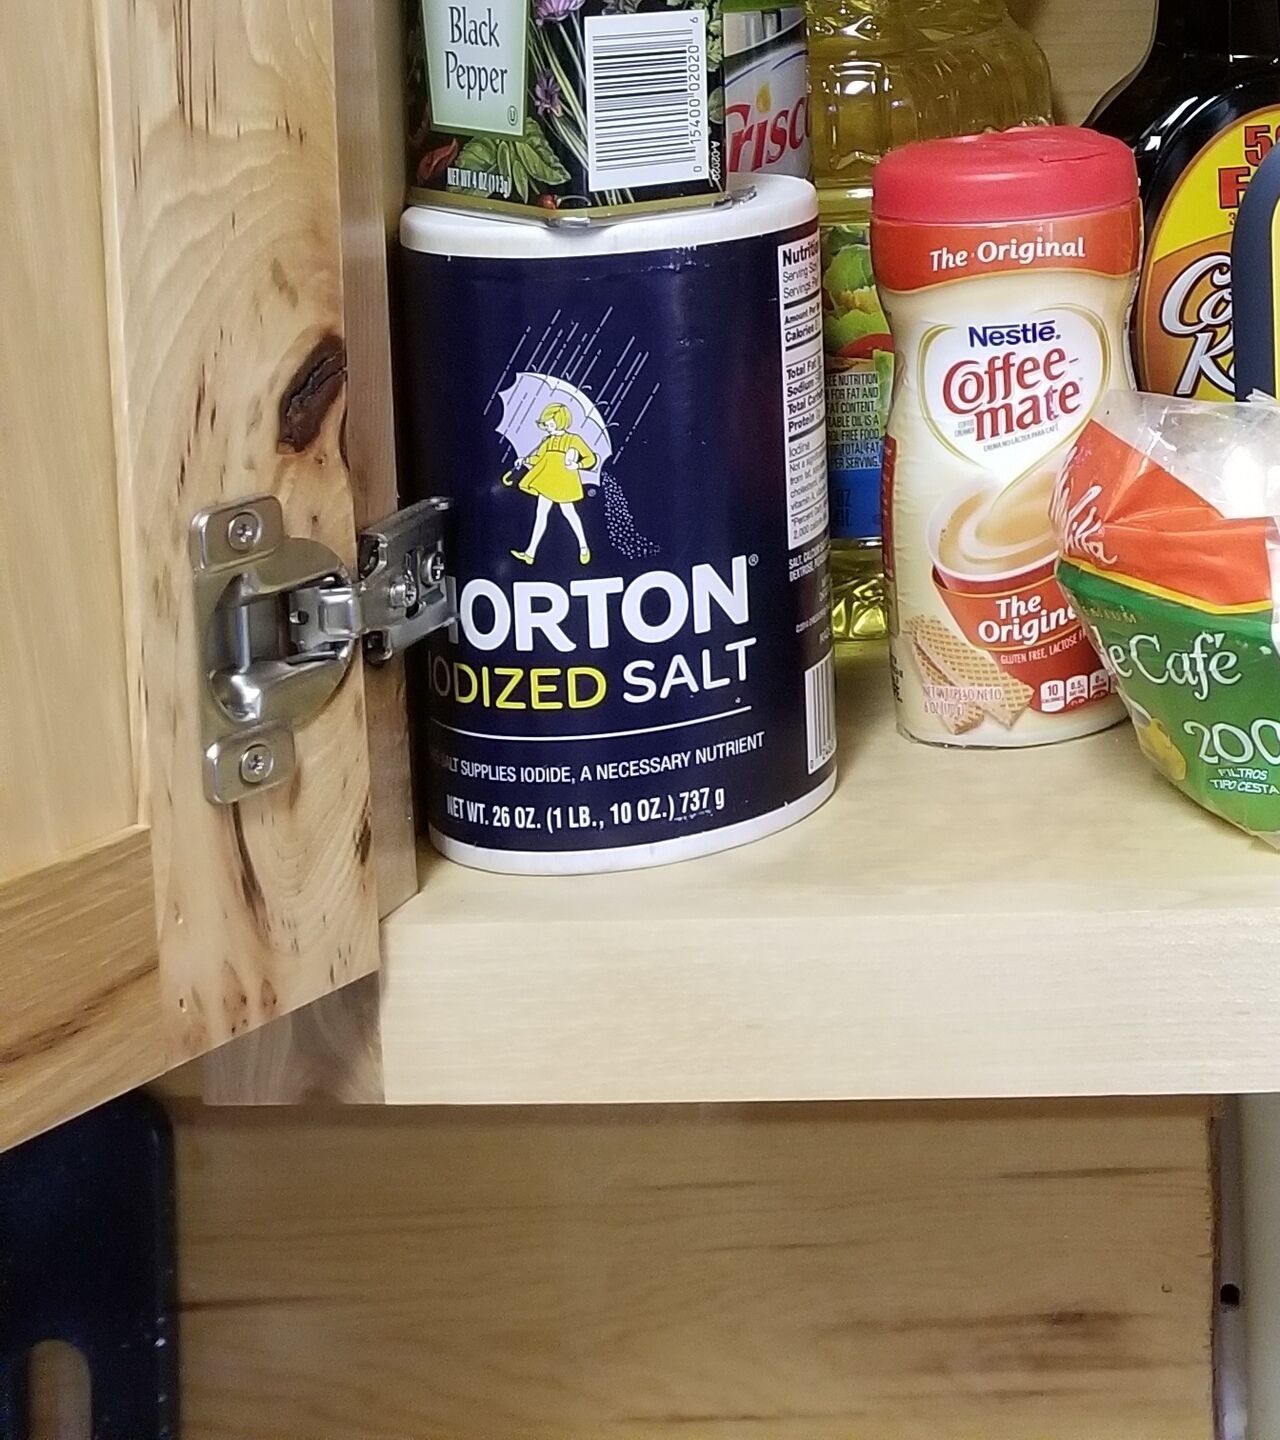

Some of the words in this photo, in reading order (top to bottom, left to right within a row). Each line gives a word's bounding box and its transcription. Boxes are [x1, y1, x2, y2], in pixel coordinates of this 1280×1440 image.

[449, 6, 500, 47] Black
[445, 51, 508, 101] Pepper
[478, 172, 487, 191] OZ
[930, 247, 968, 271] The
[977, 237, 1086, 265] Original
[786, 364, 806, 380] Total
[839, 373, 878, 386] NUTRITION
[832, 389, 846, 400] FOR
[847, 388, 860, 399] FAT
[863, 387, 878, 397] AND
[788, 399, 806, 415] Total
[975, 380, 1081, 441] mate
[866, 441, 879, 454] FAT
[449, 555, 749, 653] ORTON
[996, 595, 1041, 620] The
[1000, 654, 1027, 664] GLUTEN
[1049, 638, 1077, 655] LACTOSE
[427, 658, 607, 710] IODIZED
[623, 638, 756, 704] SALT
[1129, 632, 1242, 701] Café
[1048, 684, 1058, 696] 10
[461, 761, 516, 781] SUPPLIES
[521, 766, 575, 784] IODIDE,
[580, 766, 592, 781] A
[597, 751, 691, 780] NECESSARY
[695, 731, 765, 765] NUTRIENT
[1218, 768, 1268, 781] FILTROS
[1238, 779, 1280, 795] CESTA
[447, 794, 464, 819] NET
[466, 800, 489, 826] WT.
[492, 804, 510, 827] 26
[514, 807, 541, 829] OZ.
[547, 806, 562, 834] (1
[610, 802, 630, 824] 10
[637, 795, 674, 822] OZ.)
[679, 787, 710, 813] 737
[714, 787, 725, 808] g
